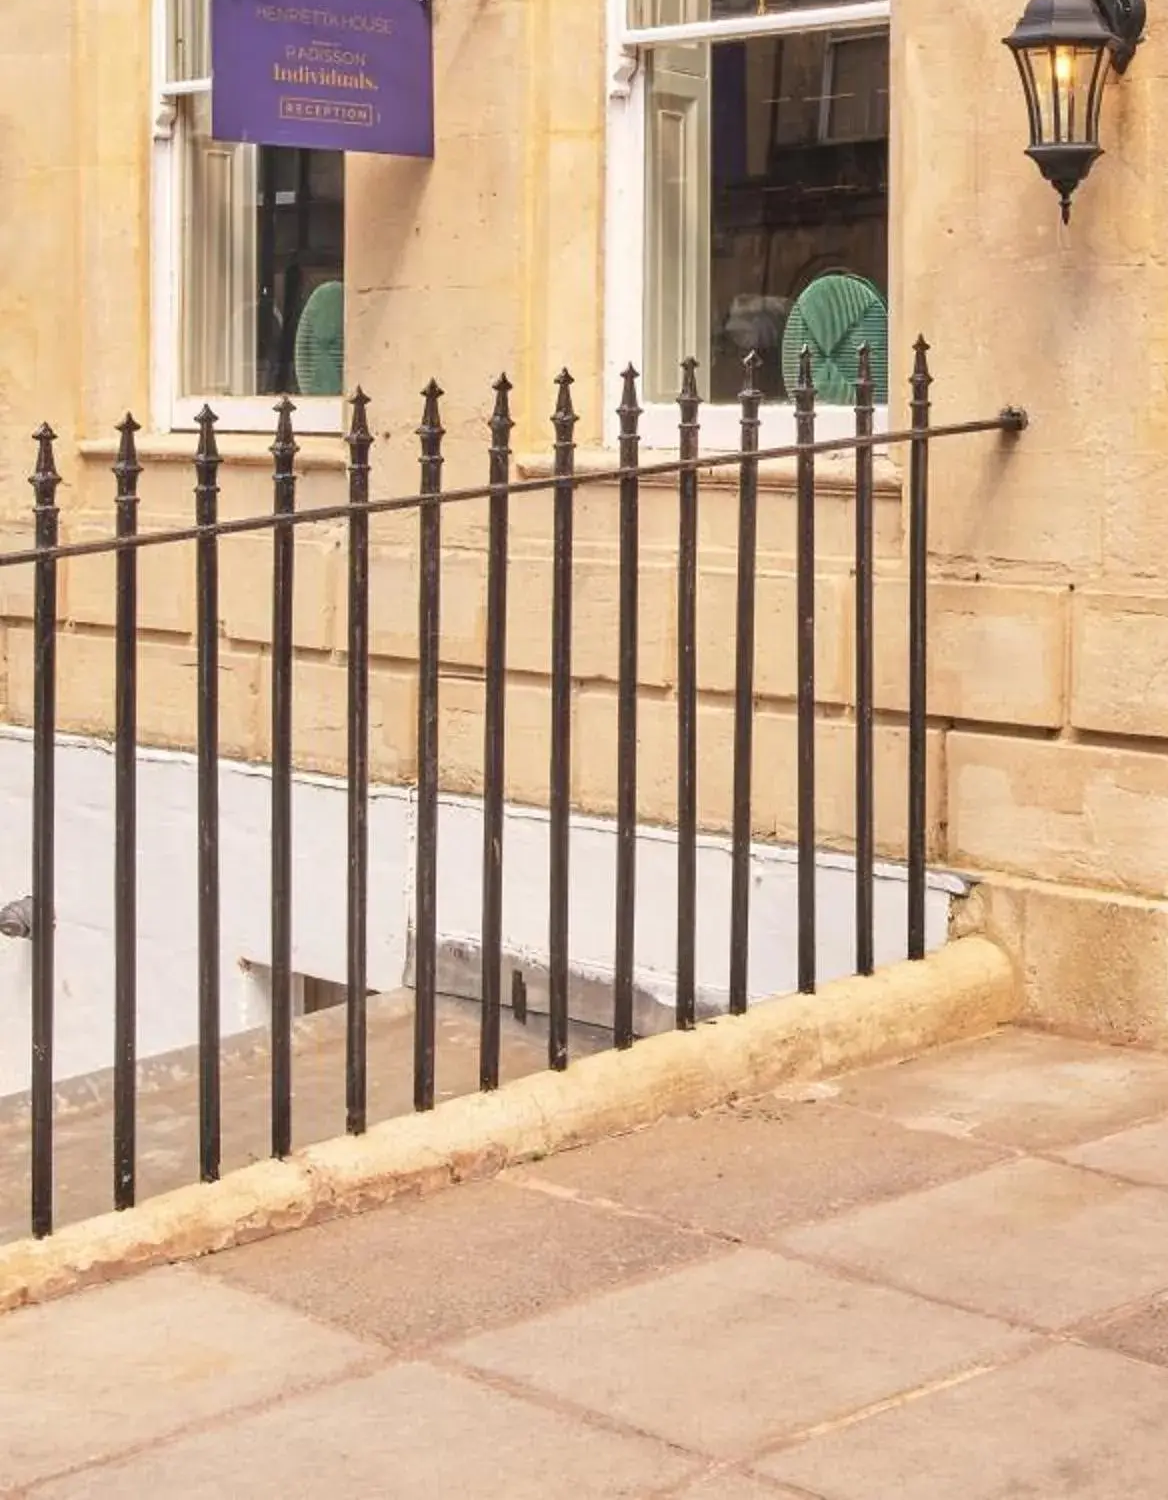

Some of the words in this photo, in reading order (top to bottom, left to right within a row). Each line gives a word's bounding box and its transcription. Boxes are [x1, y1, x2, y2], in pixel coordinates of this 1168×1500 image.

[341, 13, 393, 35] HOUSE
[285, 45, 367, 67] RADISSON
[273, 62, 380, 91] Individuals.
[286, 103, 368, 121] RECEPTION
